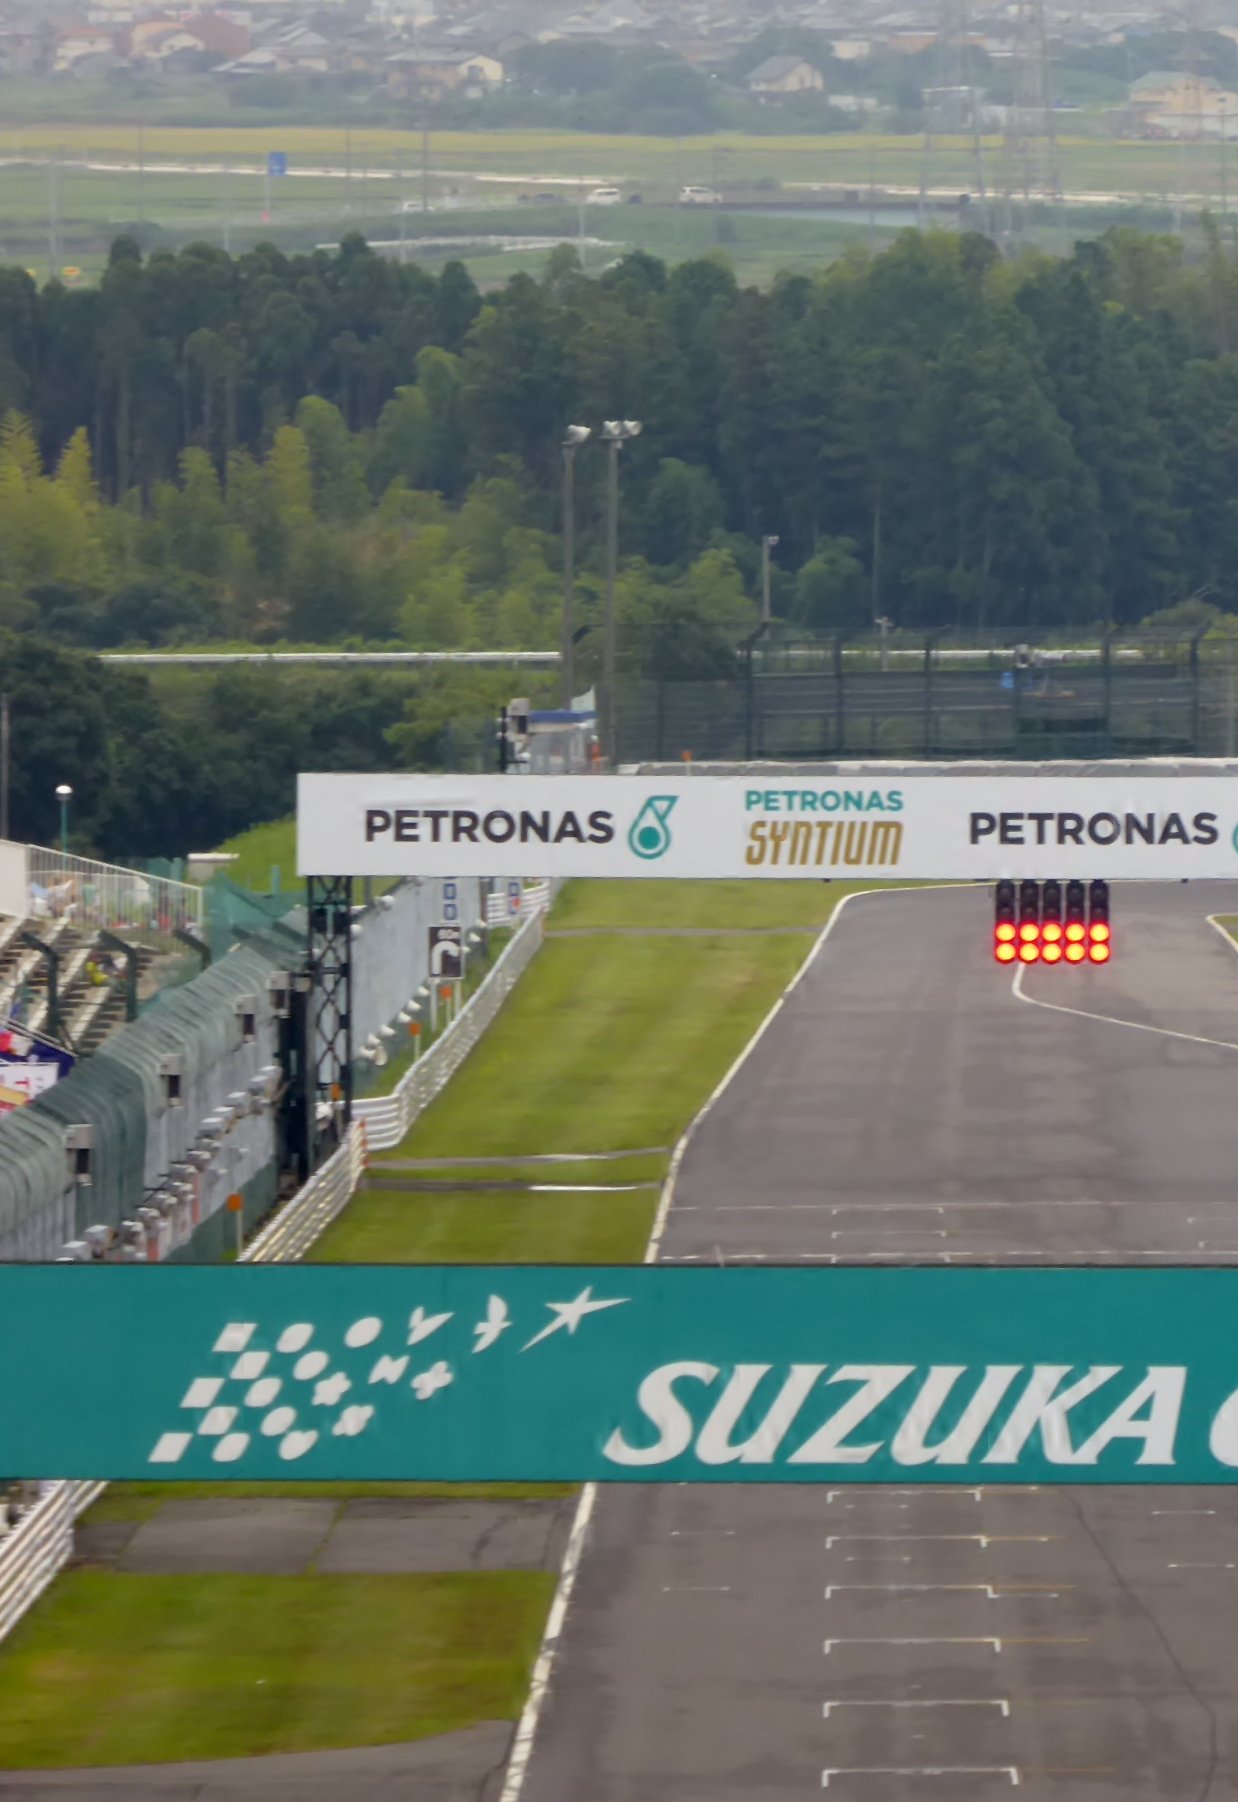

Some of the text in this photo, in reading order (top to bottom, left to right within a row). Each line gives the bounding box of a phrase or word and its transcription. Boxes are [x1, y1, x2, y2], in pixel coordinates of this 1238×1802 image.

[745, 790, 904, 812] PETRONAS
[366, 810, 614, 843] PETRONAS
[745, 820, 904, 866] SYNTIUM
[970, 812, 1218, 845] PETRONAS
[603, 1361, 1187, 1466] SUZUKA
